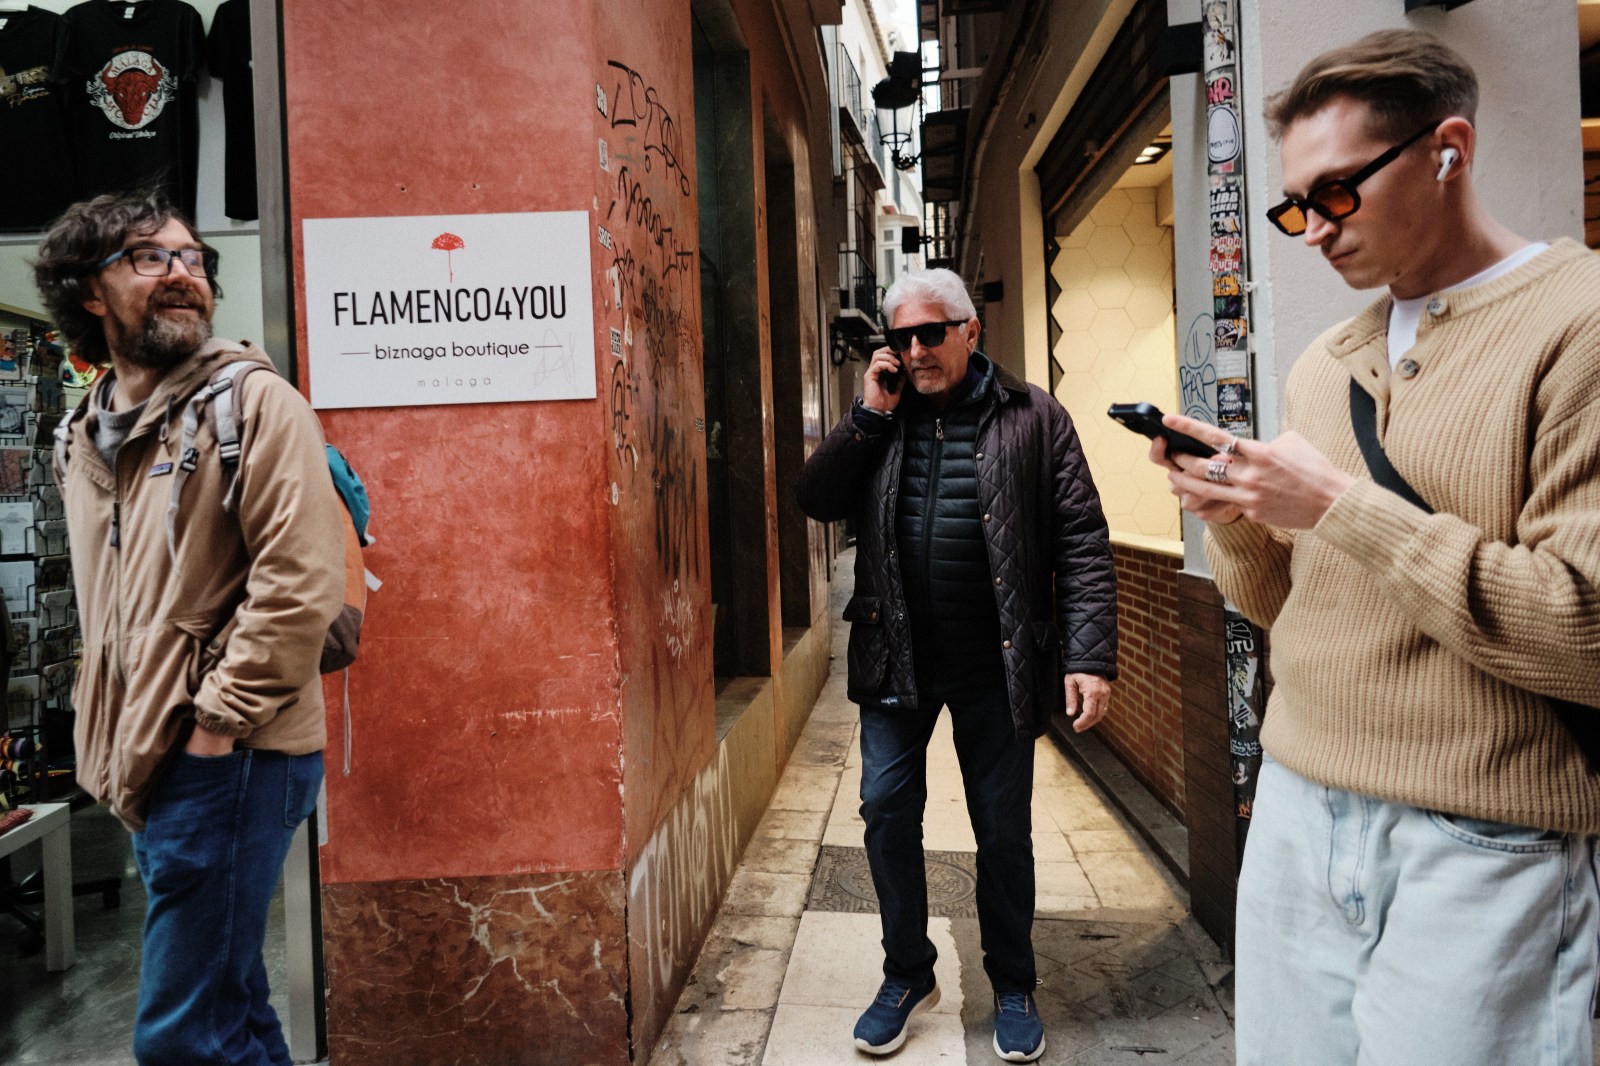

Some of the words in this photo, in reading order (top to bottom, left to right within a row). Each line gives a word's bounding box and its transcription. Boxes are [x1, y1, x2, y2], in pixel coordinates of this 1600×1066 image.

[333, 285, 567, 327] FLAMENCO4YOU
[375, 344, 447, 361] biznaga
[451, 341, 530, 359] boutique
[417, 376, 491, 388] malaga
